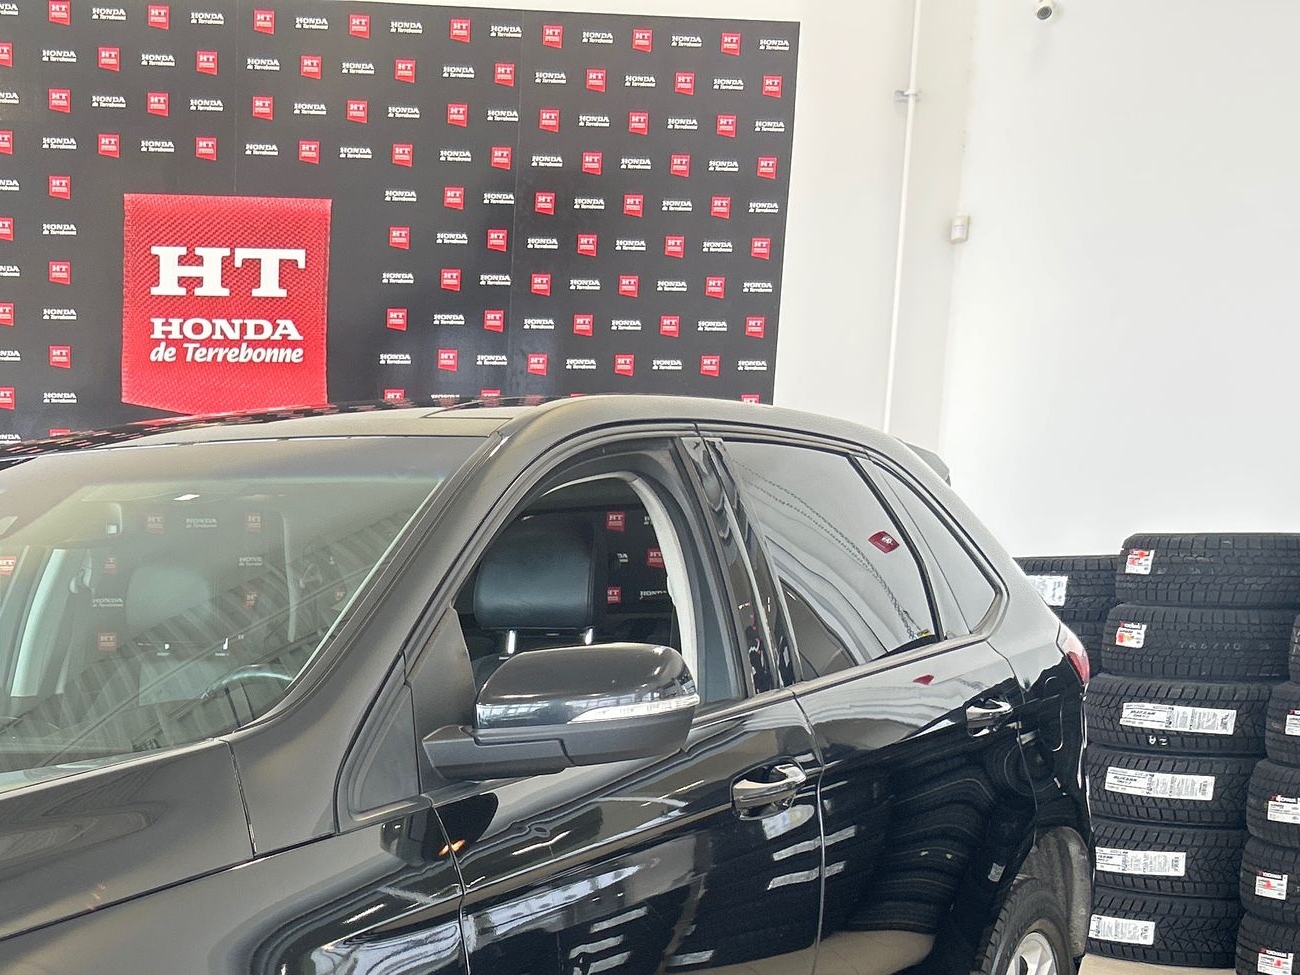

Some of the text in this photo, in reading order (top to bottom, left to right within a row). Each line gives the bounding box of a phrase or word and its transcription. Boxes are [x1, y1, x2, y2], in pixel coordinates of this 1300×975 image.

[150, 245, 306, 298] HT
[150, 317, 304, 341] HONDA
[149, 341, 304, 363] de Terrebonne
